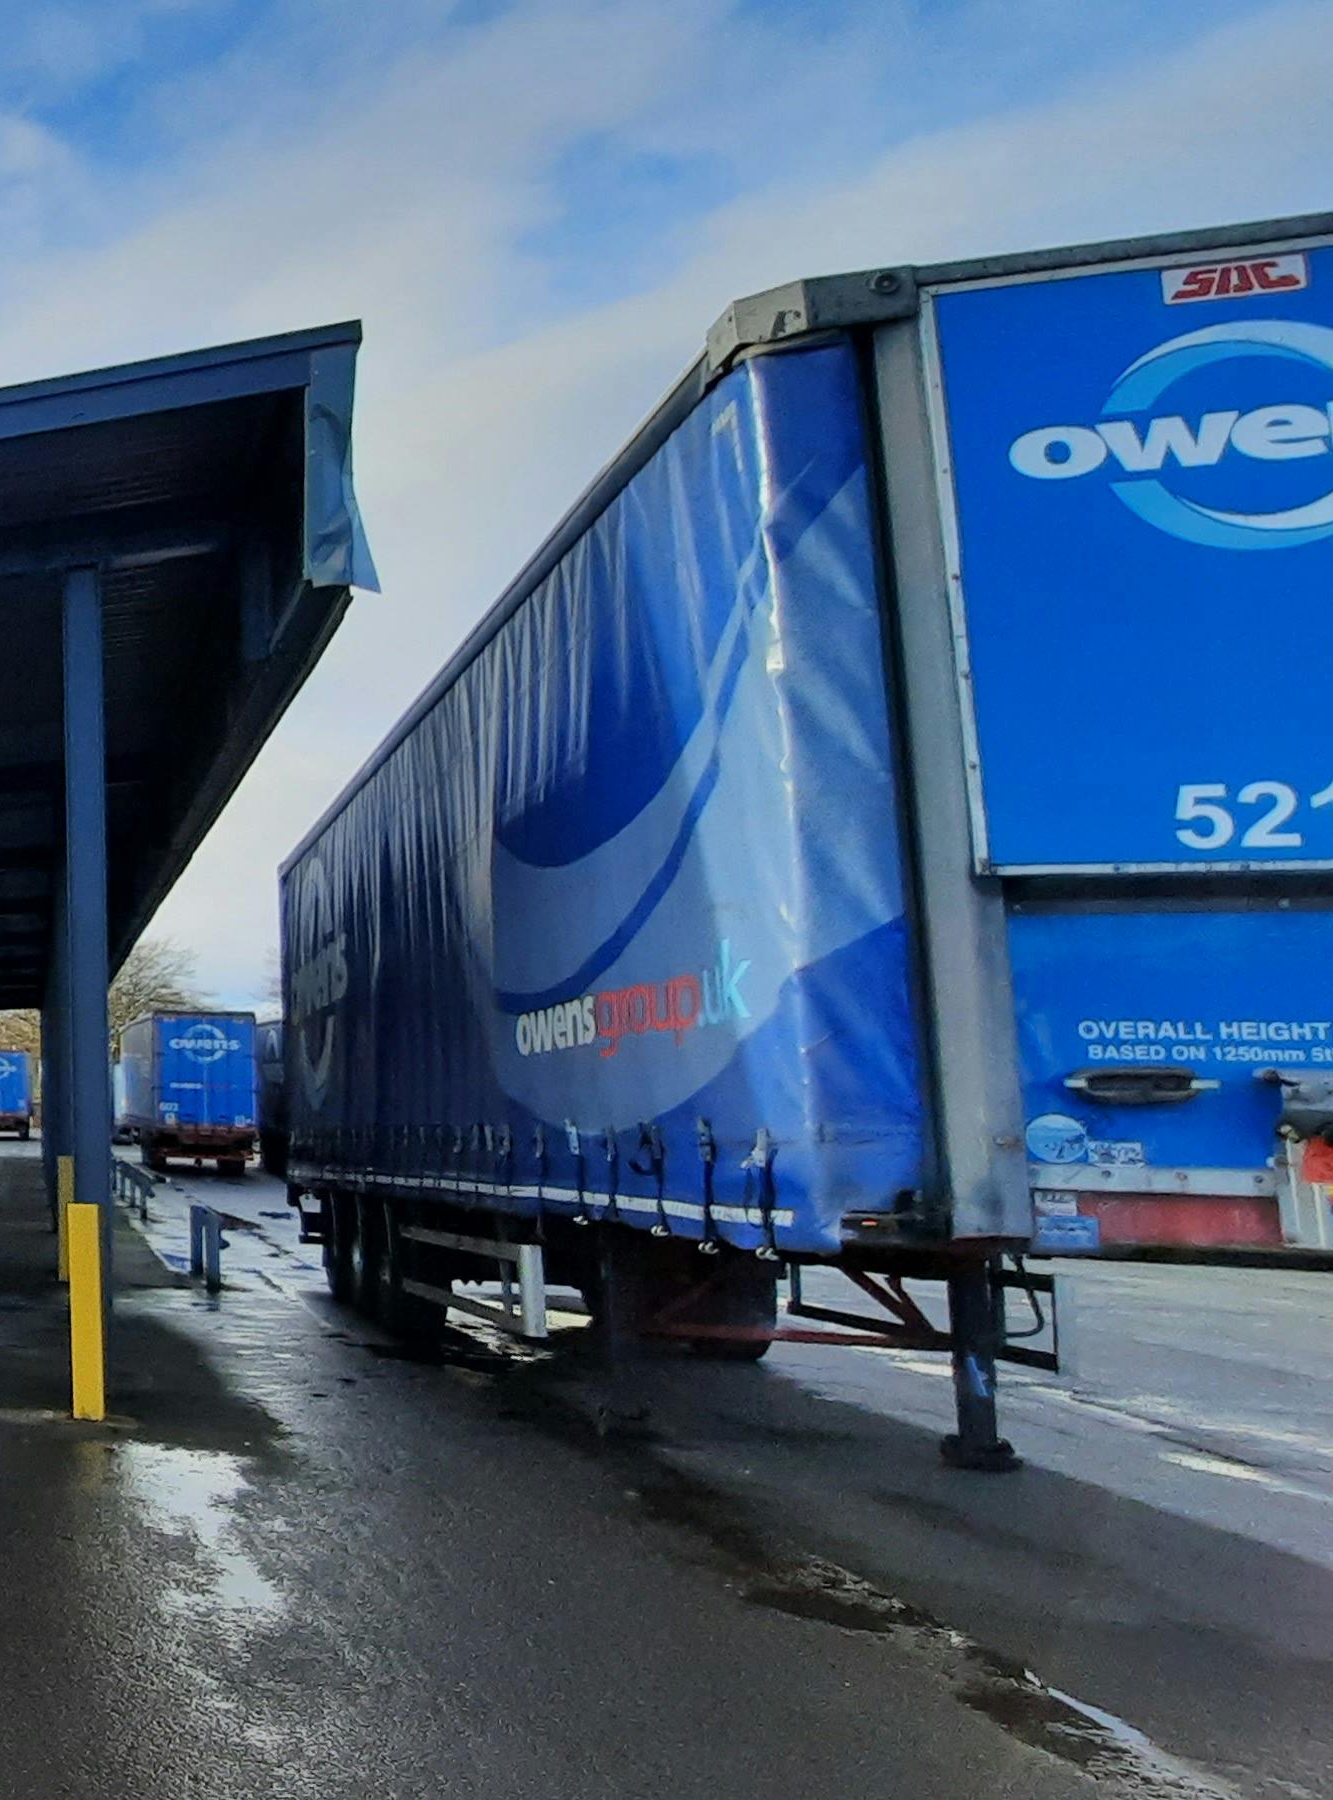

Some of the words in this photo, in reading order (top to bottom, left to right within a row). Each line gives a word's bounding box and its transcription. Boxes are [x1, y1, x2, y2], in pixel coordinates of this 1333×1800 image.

[1170, 261, 1301, 300] SDC
[1008, 401, 1333, 479] owe
[1078, 1021, 1213, 1040] OVERALL
[1219, 1022, 1331, 1041] HEIGHT
[1088, 1045, 1165, 1060] BASED
[1172, 1046, 1205, 1061] ON
[1214, 1047, 1306, 1062] 1250mm
